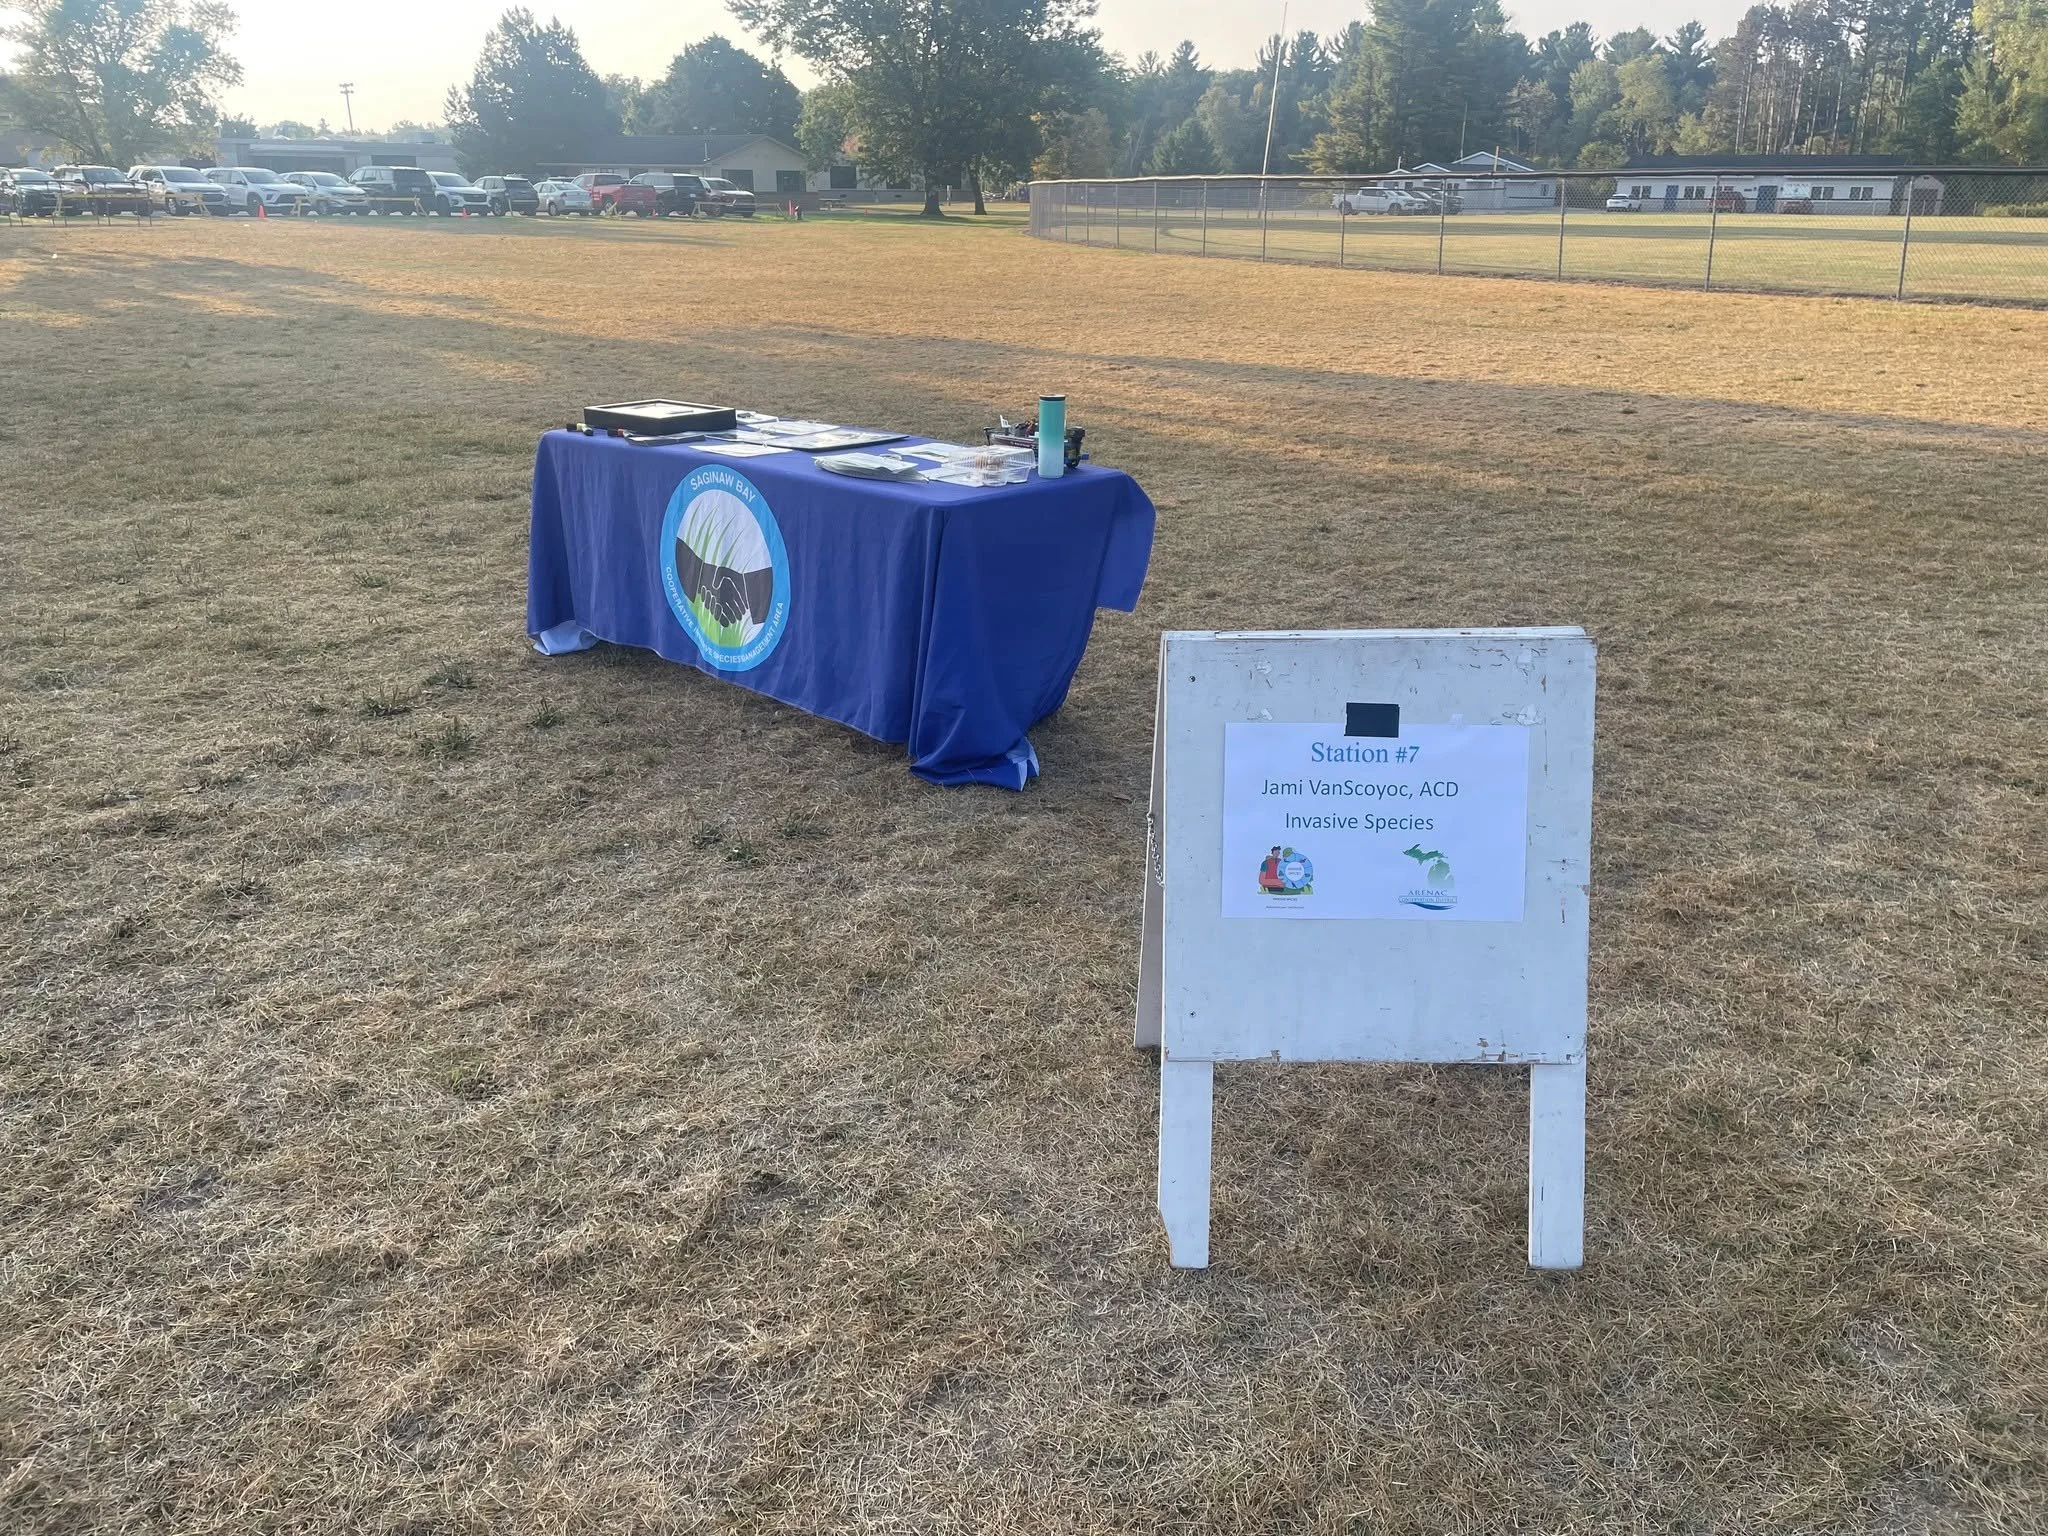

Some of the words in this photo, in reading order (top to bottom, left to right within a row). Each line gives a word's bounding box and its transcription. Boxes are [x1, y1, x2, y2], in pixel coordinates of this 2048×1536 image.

[690, 471, 735, 491] SAGINAW
[735, 480, 756, 503] BAY
[666, 566, 695, 628] COOPERATIVE
[772, 602, 784, 627] AREA
[1311, 742, 1389, 763] Station
[1395, 745, 1420, 763] #7
[1261, 779, 1303, 796] Jami
[1309, 779, 1414, 800] VanScoyoc,
[1419, 781, 1459, 797] ACD
[1285, 812, 1358, 829] Invasive
[1364, 813, 1434, 833] Species
